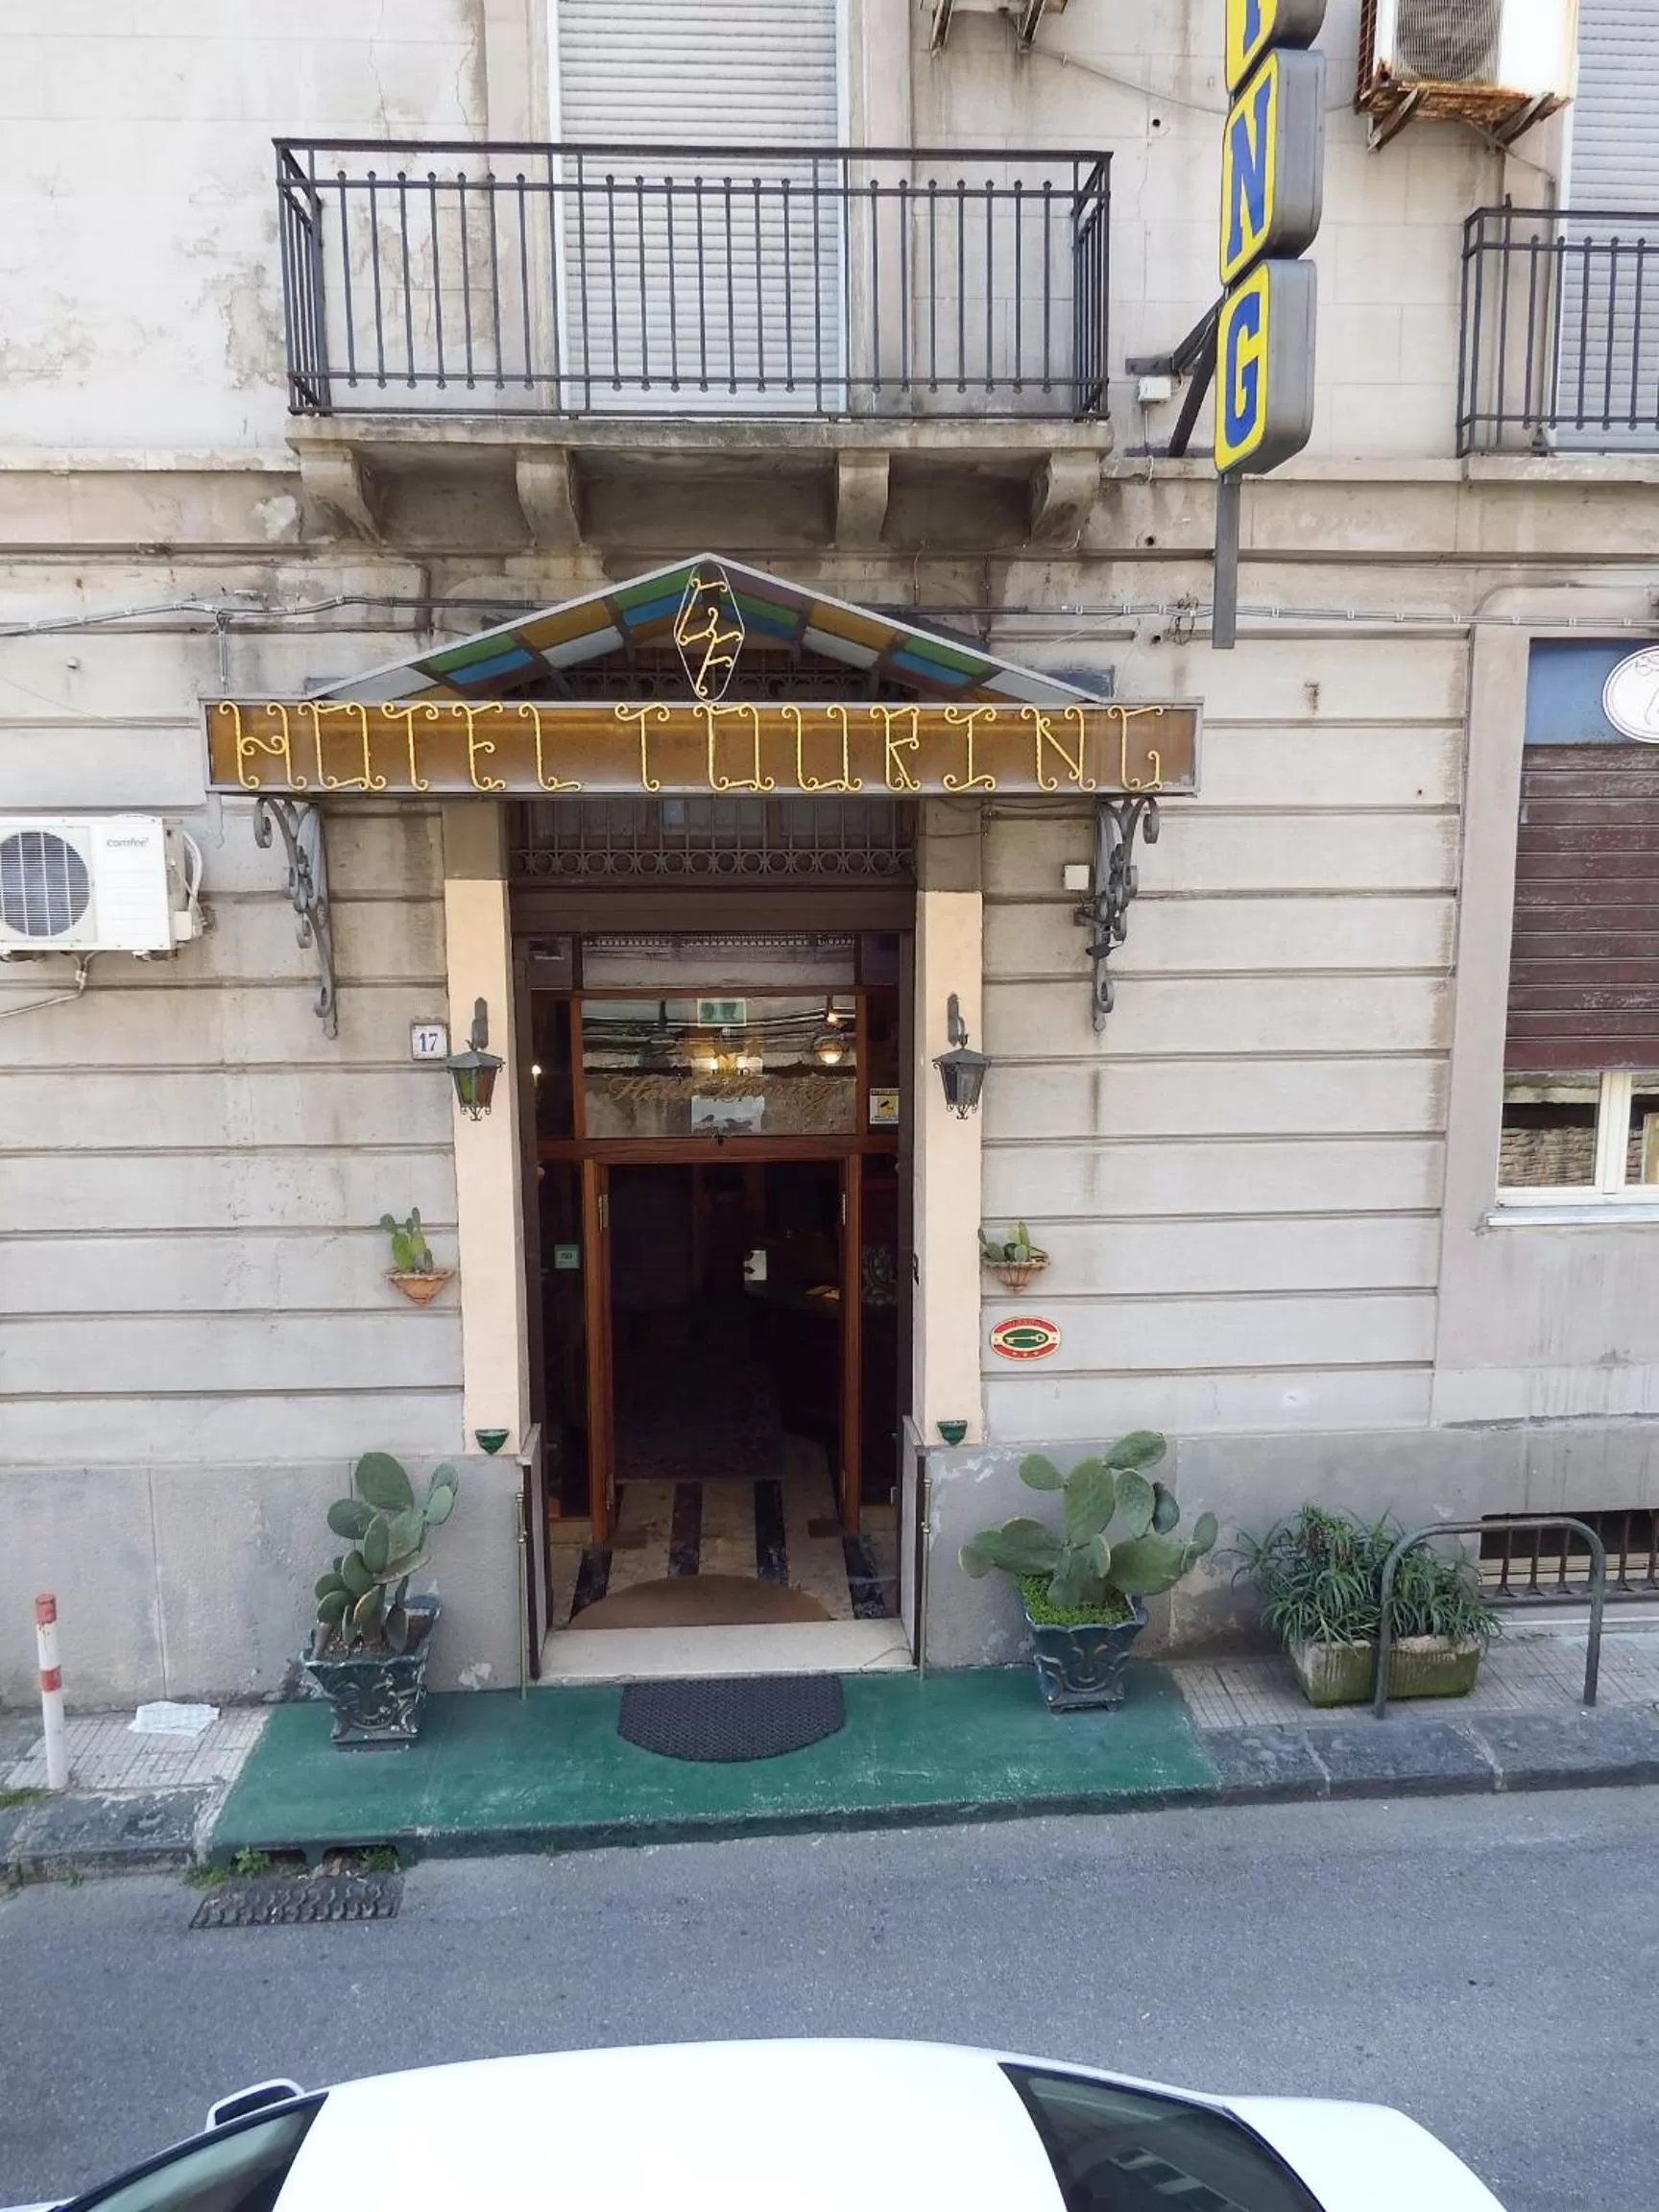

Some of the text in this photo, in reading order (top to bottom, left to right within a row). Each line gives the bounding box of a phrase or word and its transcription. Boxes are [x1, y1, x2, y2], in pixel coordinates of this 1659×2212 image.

[219, 700, 1163, 792] HOTEL TOURING
[420, 1032, 438, 1052] 17
